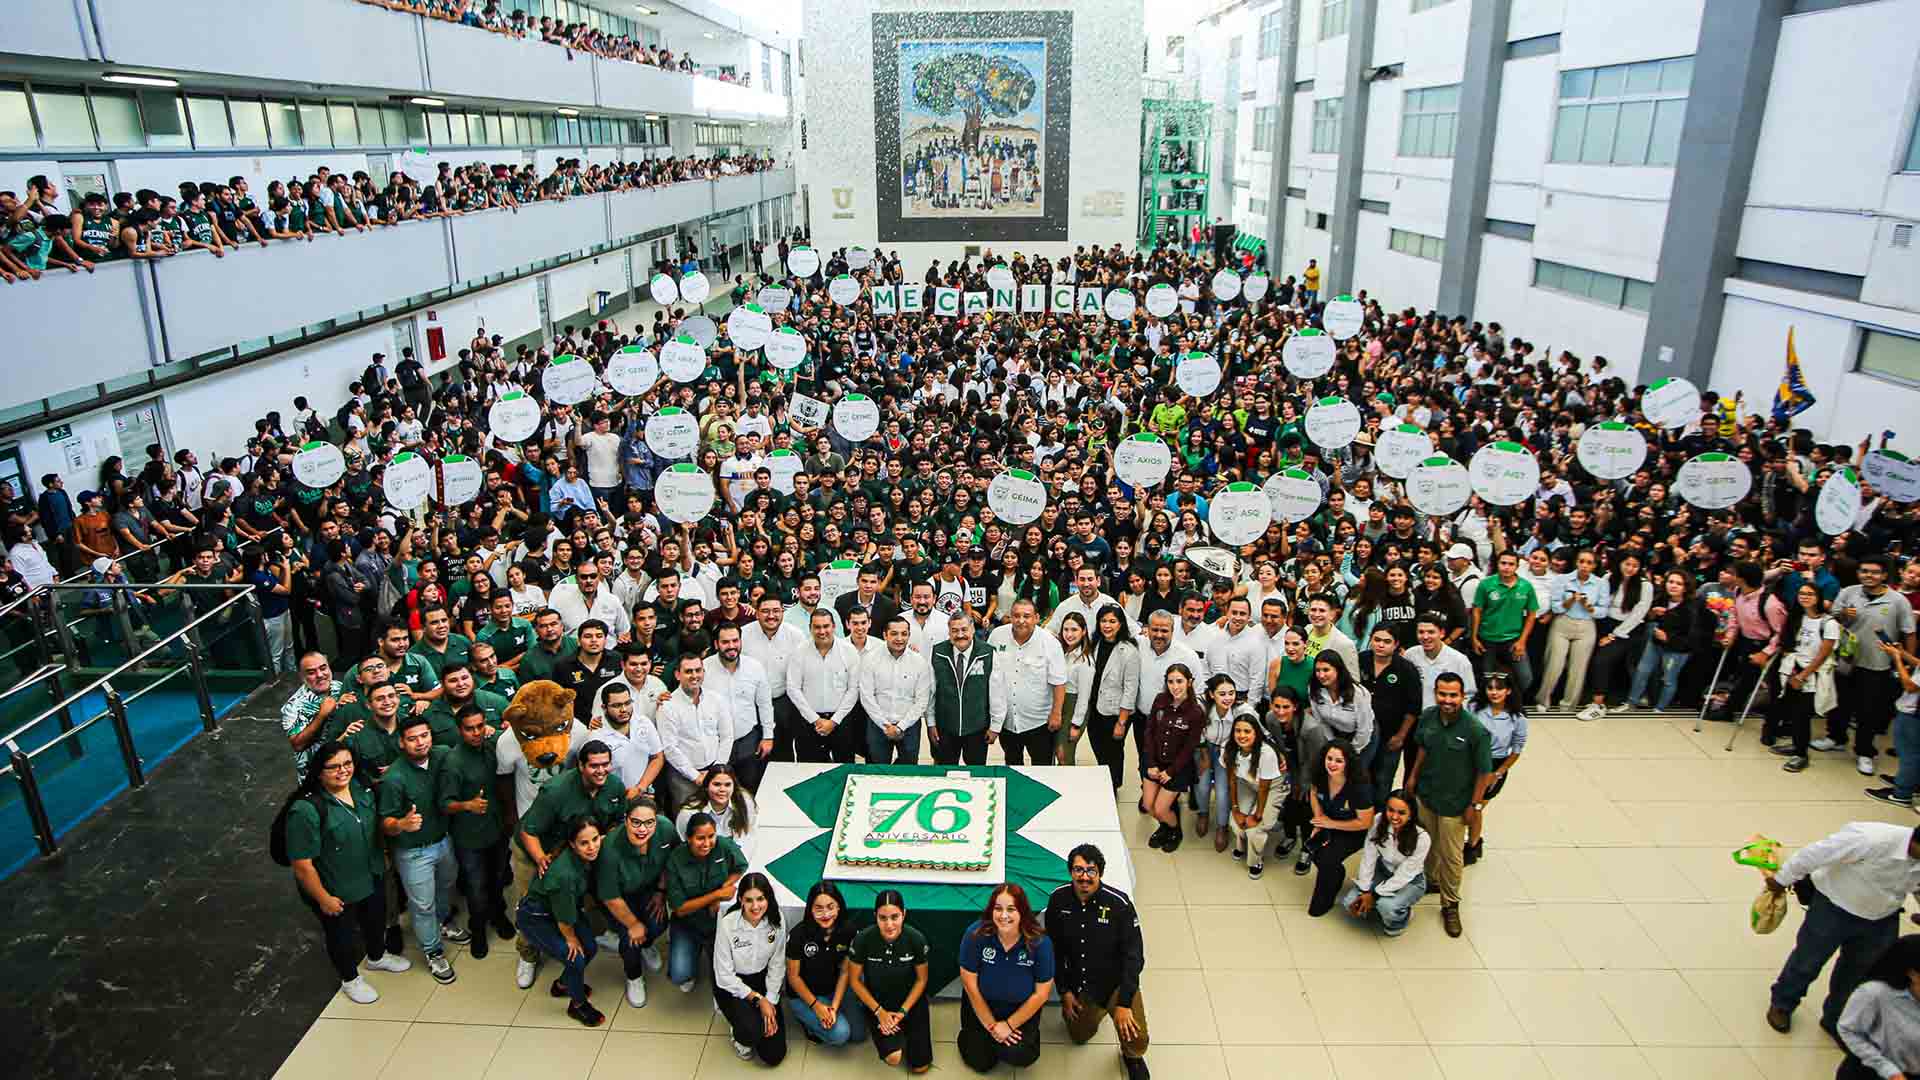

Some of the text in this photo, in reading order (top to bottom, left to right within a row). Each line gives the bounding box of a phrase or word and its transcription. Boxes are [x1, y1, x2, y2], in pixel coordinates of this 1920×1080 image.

[1136, 455, 1162, 466] AXIOS
[1011, 493, 1039, 506] GEIMA
[870, 789, 972, 833] 76
